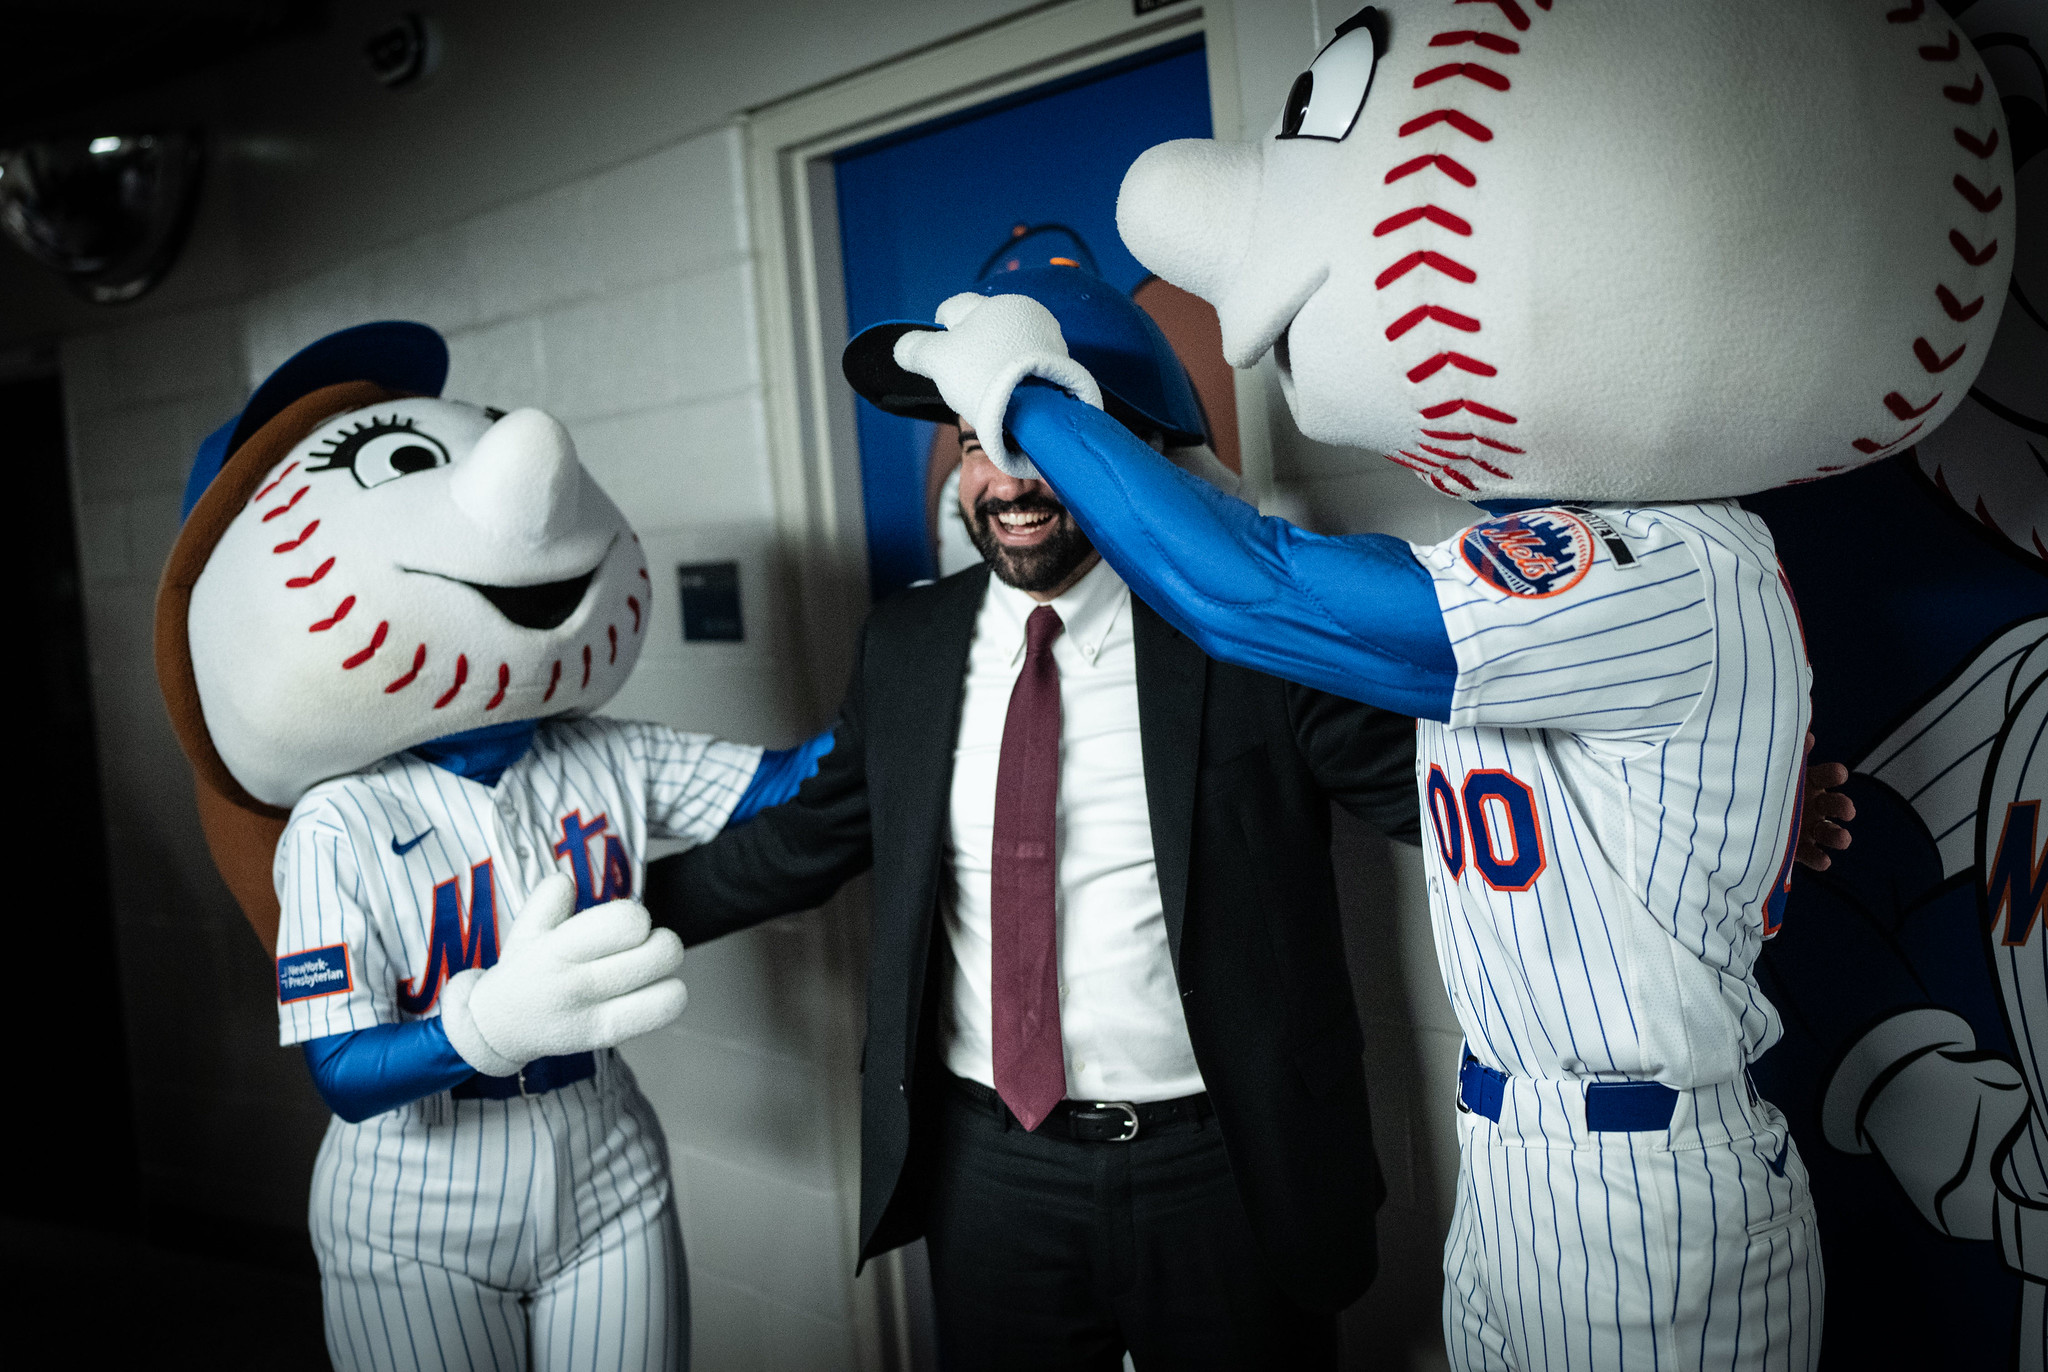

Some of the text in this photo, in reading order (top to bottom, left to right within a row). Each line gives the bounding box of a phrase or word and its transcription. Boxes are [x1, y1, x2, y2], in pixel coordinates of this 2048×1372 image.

[1479, 527, 1560, 580] Mets
[1427, 762, 1547, 892] 00
[397, 808, 633, 1014] Mts
[288, 968, 344, 988] Presbyterian
